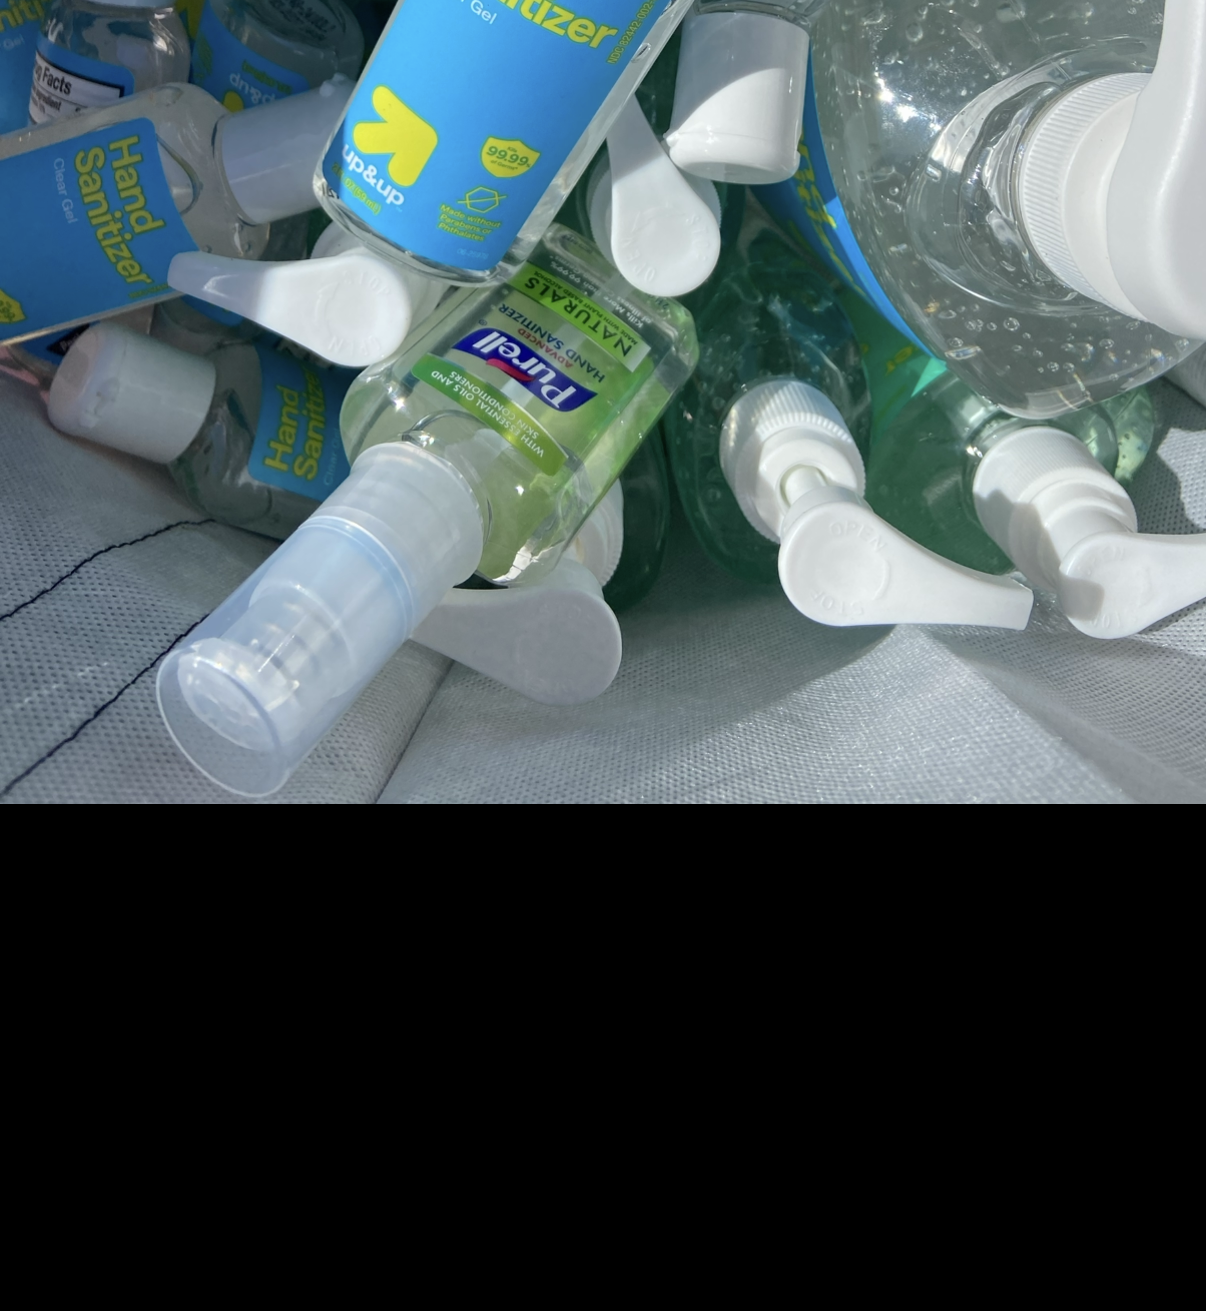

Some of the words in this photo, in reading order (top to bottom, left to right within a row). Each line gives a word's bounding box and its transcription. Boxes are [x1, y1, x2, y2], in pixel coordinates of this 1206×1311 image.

[470, 0, 498, 25] Gel
[605, 45, 625, 65] NDC
[42, 67, 73, 98] Facts
[229, 71, 278, 105] p&up
[108, 134, 167, 235] Hand
[341, 143, 406, 207] up&up
[53, 157, 68, 196] Clear
[61, 198, 79, 225] Gel
[74, 145, 154, 285] Sanitizer
[438, 213, 482, 233] Parabens
[481, 226, 493, 236] or
[439, 203, 467, 220] Made
[466, 213, 502, 229] without
[437, 221, 486, 243] Phthalates
[533, 270, 564, 291] ALCOHOL
[562, 288, 585, 308] BASED
[583, 301, 604, 319] PLANT
[602, 295, 627, 314] More
[497, 302, 565, 351] SANITIZER
[524, 275, 634, 358] NATURALS
[603, 316, 621, 331] WITH
[625, 312, 645, 329] Kills
[517, 327, 575, 370] ADVANCED
[620, 328, 639, 346] MADE
[430, 368, 458, 387] AND
[471, 330, 578, 410] Purell
[564, 348, 606, 384] HAND
[450, 370, 517, 422] CONDITIONERS
[452, 383, 476, 402] OILS
[263, 384, 300, 473] Hand
[474, 399, 522, 438] ESSENTIAL
[516, 419, 540, 441] SKIN
[520, 434, 545, 459] WITH
[828, 521, 887, 554] OPEN
